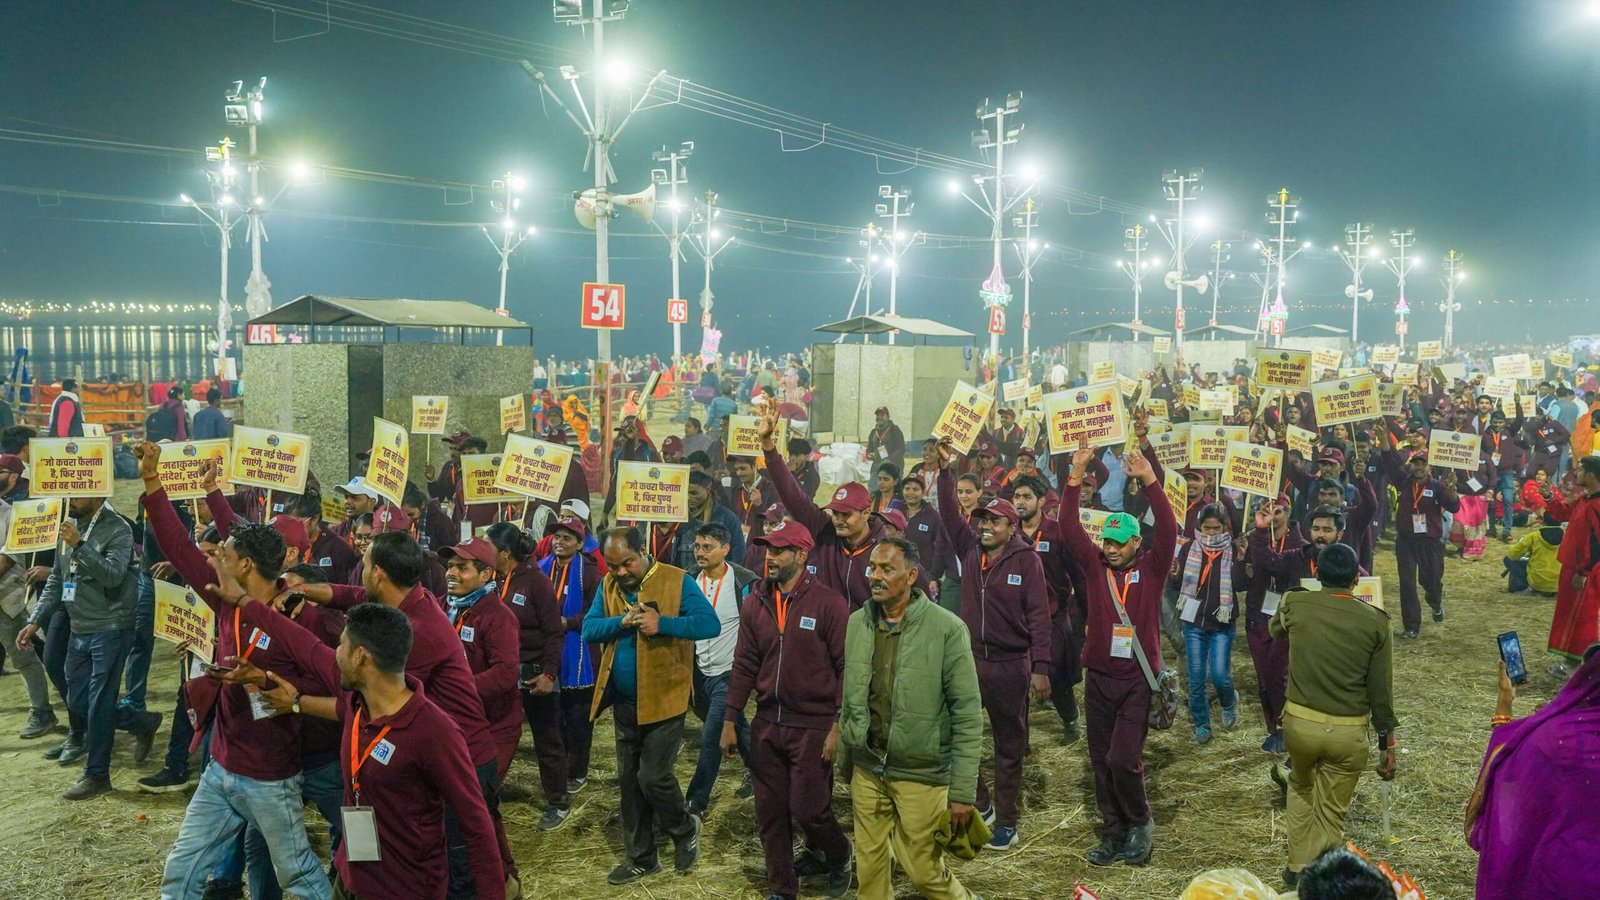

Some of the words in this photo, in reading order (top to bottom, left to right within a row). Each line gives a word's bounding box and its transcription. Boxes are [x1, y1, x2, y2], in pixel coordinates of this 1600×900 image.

[591, 288, 619, 321] 54
[671, 303, 684, 320] 45
[251, 324, 271, 344] 46
[1058, 408, 1085, 419] “जन-जन
[1086, 406, 1095, 414] का
[1096, 404, 1105, 413] यह
[1058, 423, 1068, 431] अब
[1070, 420, 1085, 429] नारा,
[1086, 415, 1114, 427] महाकुम्भ
[1063, 432, 1069, 442] हो
[1071, 432, 1086, 441] स्व
[1087, 427, 1111, 438] हमारा।”
[41, 457, 54, 466] “जो
[78, 457, 102, 466] फैलाता
[217, 456, 223, 465] ये
[248, 447, 262, 456] “हम
[264, 448, 275, 459] नई
[277, 450, 295, 462] चेतना
[242, 457, 263, 468] लाएंगे,
[278, 464, 296, 473] कचरा
[512, 454, 522, 462] “जो
[523, 456, 539, 468] कचरा
[541, 460, 561, 473] फैलाता
[60, 468, 74, 478] फिर
[77, 470, 93, 480] पुण्य
[160, 471, 185, 481] संदेश,
[258, 469, 289, 483] फैलाएंगे।”
[523, 467, 534, 478] फिर
[536, 472, 550, 482] पुण्य
[42, 480, 56, 489] कहां
[89, 480, 101, 489] है।”
[164, 483, 188, 491] अपना
[191, 480, 197, 489] ये
[506, 474, 519, 484] कहां
[529, 481, 542, 490] पाता
[542, 484, 553, 493] है।”
[626, 480, 637, 490] “जो
[639, 482, 657, 490] कचरा
[659, 482, 681, 492] फैलाता
[643, 492, 656, 502] फिर
[658, 495, 672, 505] पुण्य
[626, 503, 639, 512] कहां
[667, 504, 678, 514] है।”
